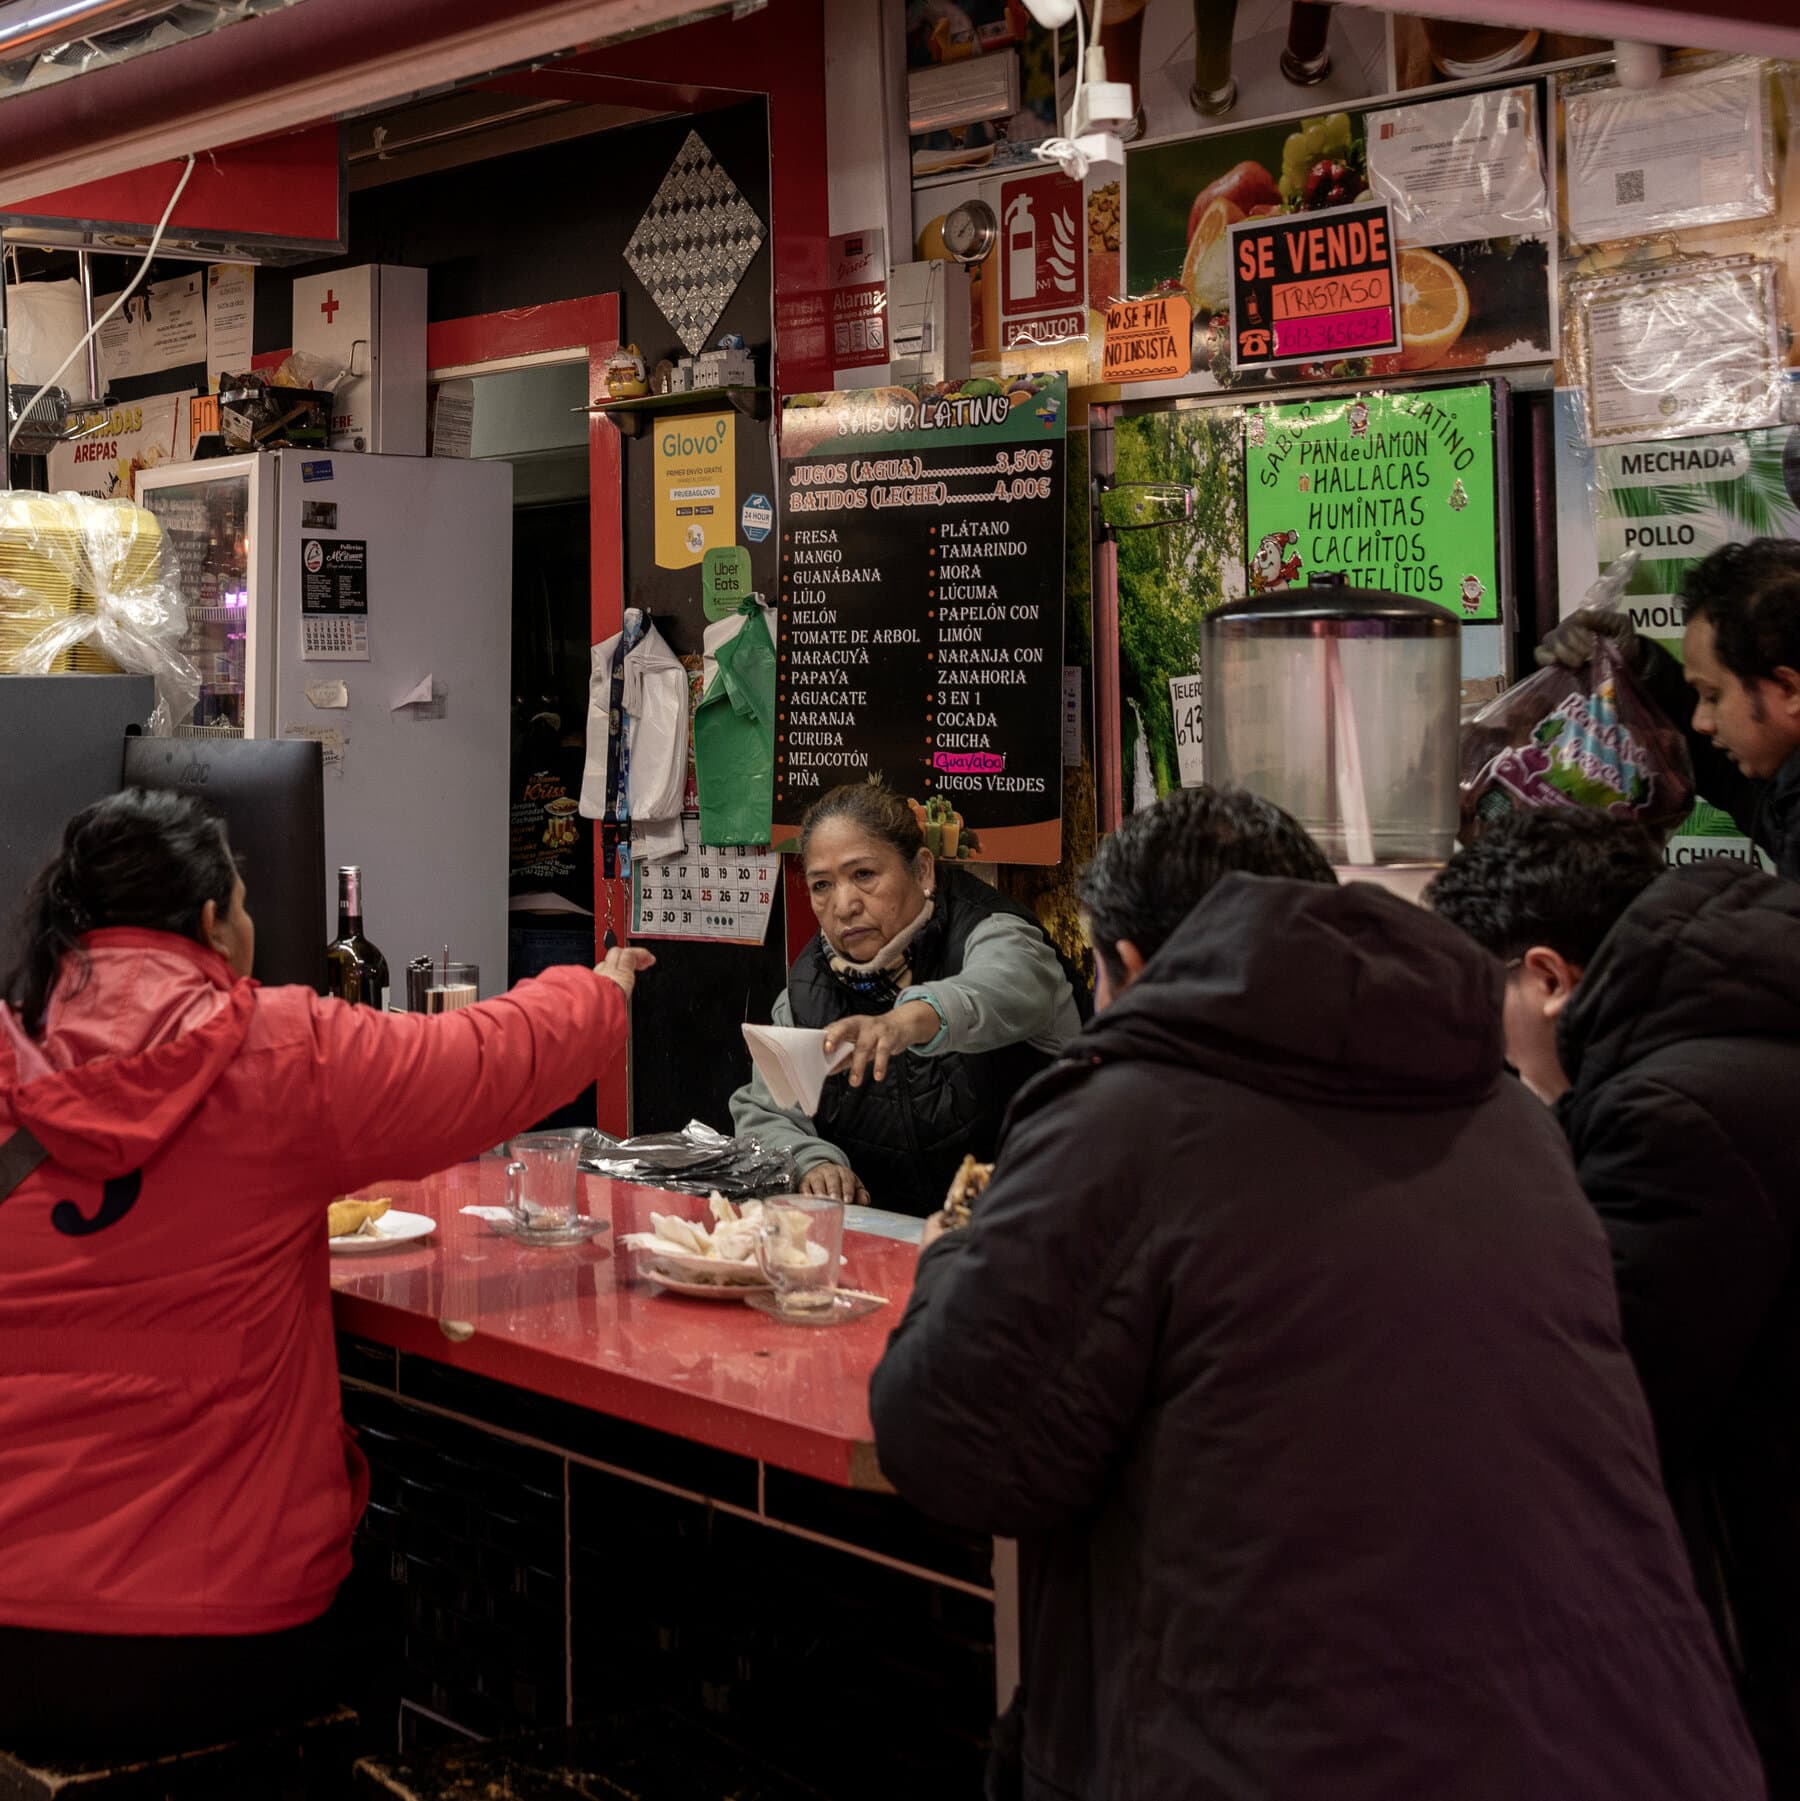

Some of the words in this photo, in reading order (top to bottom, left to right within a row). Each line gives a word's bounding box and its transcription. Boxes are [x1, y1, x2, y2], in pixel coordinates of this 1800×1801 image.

[1239, 236, 1275, 282] SE
[1286, 218, 1387, 274] VENDE
[833, 290, 886, 310] Alarma
[1275, 278, 1382, 316] TRASPASO
[1107, 309, 1120, 332] NO
[1124, 306, 1139, 330] SE
[1144, 301, 1168, 327] FIA
[1007, 317, 1079, 342] EXTINTOR
[1104, 341, 1121, 366] NO
[1124, 335, 1178, 362] INSISTA
[837, 403, 916, 435] SABOR
[919, 395, 1011, 429] LATINO
[74, 441, 118, 463] AREPAS
[662, 432, 719, 457] Glovo
[1300, 437, 1338, 465] PAN
[1340, 442, 1360, 462] de
[1363, 429, 1428, 460] JAMON
[1620, 447, 1737, 476] MECHADA
[789, 463, 848, 486] JUGOS
[1314, 461, 1430, 493] HALLACAS
[673, 488, 716, 498] PRUEBAGLOVO
[789, 488, 867, 512] BATIDOS
[744, 510, 752, 520] 24
[752, 511, 770, 522] HOUR
[794, 529, 838, 544] FRESA
[940, 520, 1010, 538] PLÁTANO
[1625, 524, 1695, 548] POLLO
[793, 550, 842, 565] MANGO
[939, 541, 1027, 559] TAMARINDO
[713, 561, 740, 576] Uber
[793, 567, 881, 584] GUANÁBANA
[939, 565, 982, 580] MORA
[713, 577, 741, 591] Eats
[939, 584, 998, 601] LÚCUMA
[792, 588, 826, 604] LÚLO
[791, 609, 837, 625] MELÓN
[939, 603, 1006, 622] PAPELÓN
[1010, 604, 1039, 620] CON
[791, 630, 847, 645] TOMATE
[850, 630, 869, 644] DE
[872, 628, 921, 644] ARBOL
[938, 624, 982, 642] LIMÓN
[938, 649, 1010, 664] NARANJA
[1013, 648, 1043, 663] CON
[791, 669, 849, 685] PAPAYA
[938, 669, 1027, 685] ZANAHORIA
[790, 691, 867, 706] AGUACATE
[938, 691, 946, 706] 3
[951, 691, 970, 705] EN
[975, 691, 981, 705] 1
[789, 711, 855, 726] NARANJA
[937, 712, 998, 728] COCADA
[788, 732, 844, 746] CURUBA
[936, 733, 991, 749] CHICHA
[788, 750, 869, 767] MELOCOTÓN
[788, 769, 820, 787] PIÑA
[935, 776, 982, 791] JUGOS
[986, 775, 1046, 793] VERDES
[737, 845, 746, 857] 13
[641, 866, 650, 877] 15
[661, 866, 670, 877] 16
[679, 867, 688, 878] 17
[700, 867, 710, 878] 18
[719, 868, 728, 879] 19
[738, 868, 750, 880] 20
[758, 869, 767, 881] 21
[642, 888, 652, 900] 22
[663, 888, 674, 900] 23
[681, 889, 692, 901] 24
[701, 890, 712, 901] 25
[720, 890, 731, 902] 26
[739, 891, 750, 903] 27
[759, 892, 770, 904] 28
[641, 911, 654, 922] 29
[662, 911, 676, 923] 30
[682, 911, 692, 923] 31
